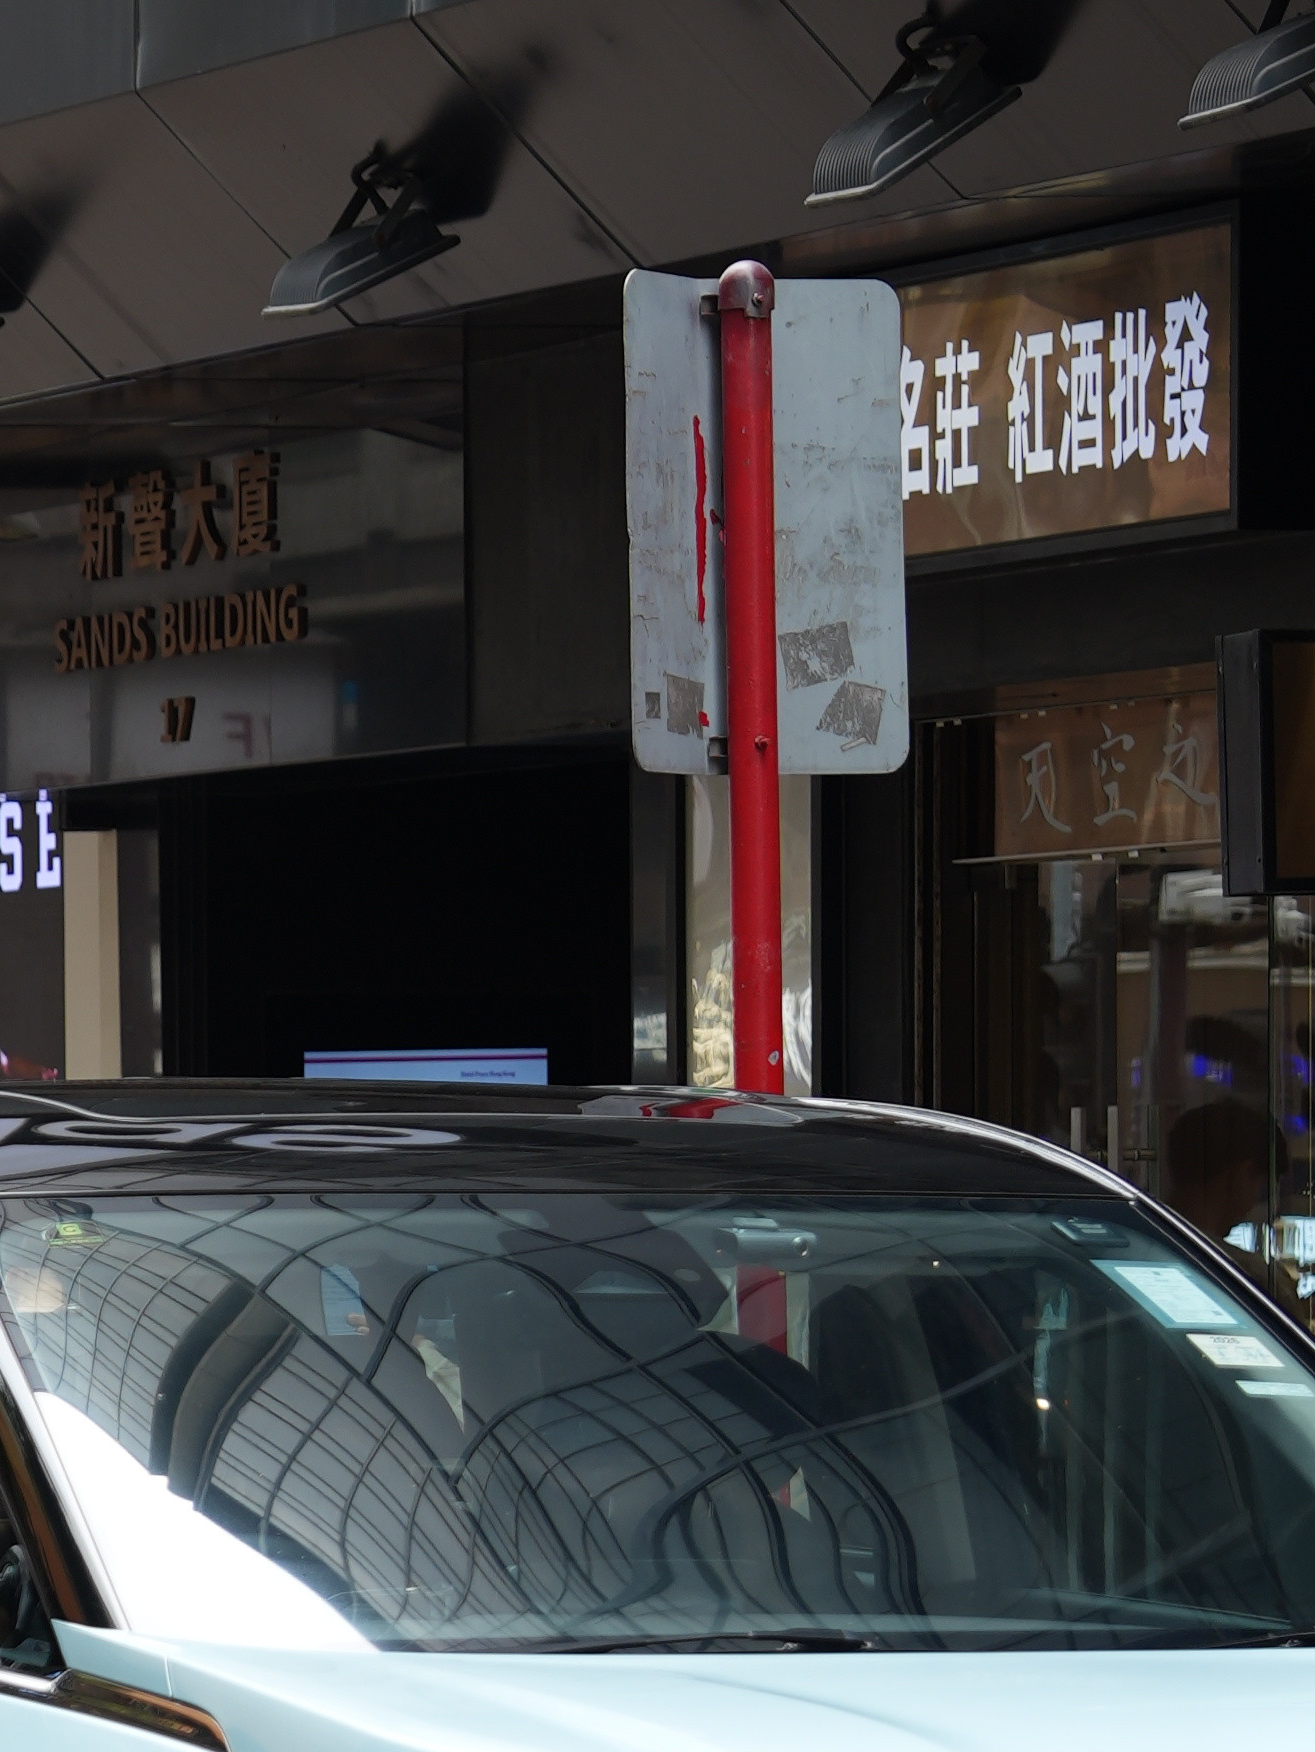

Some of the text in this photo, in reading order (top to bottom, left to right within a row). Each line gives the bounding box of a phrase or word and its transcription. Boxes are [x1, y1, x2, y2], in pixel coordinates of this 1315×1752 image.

[900, 291, 1209, 500] 名莊 紅酒批發
[78, 448, 279, 580] 新聲大廈
[55, 583, 309, 673] SANDS BUILDING
[159, 695, 196, 743] 17
